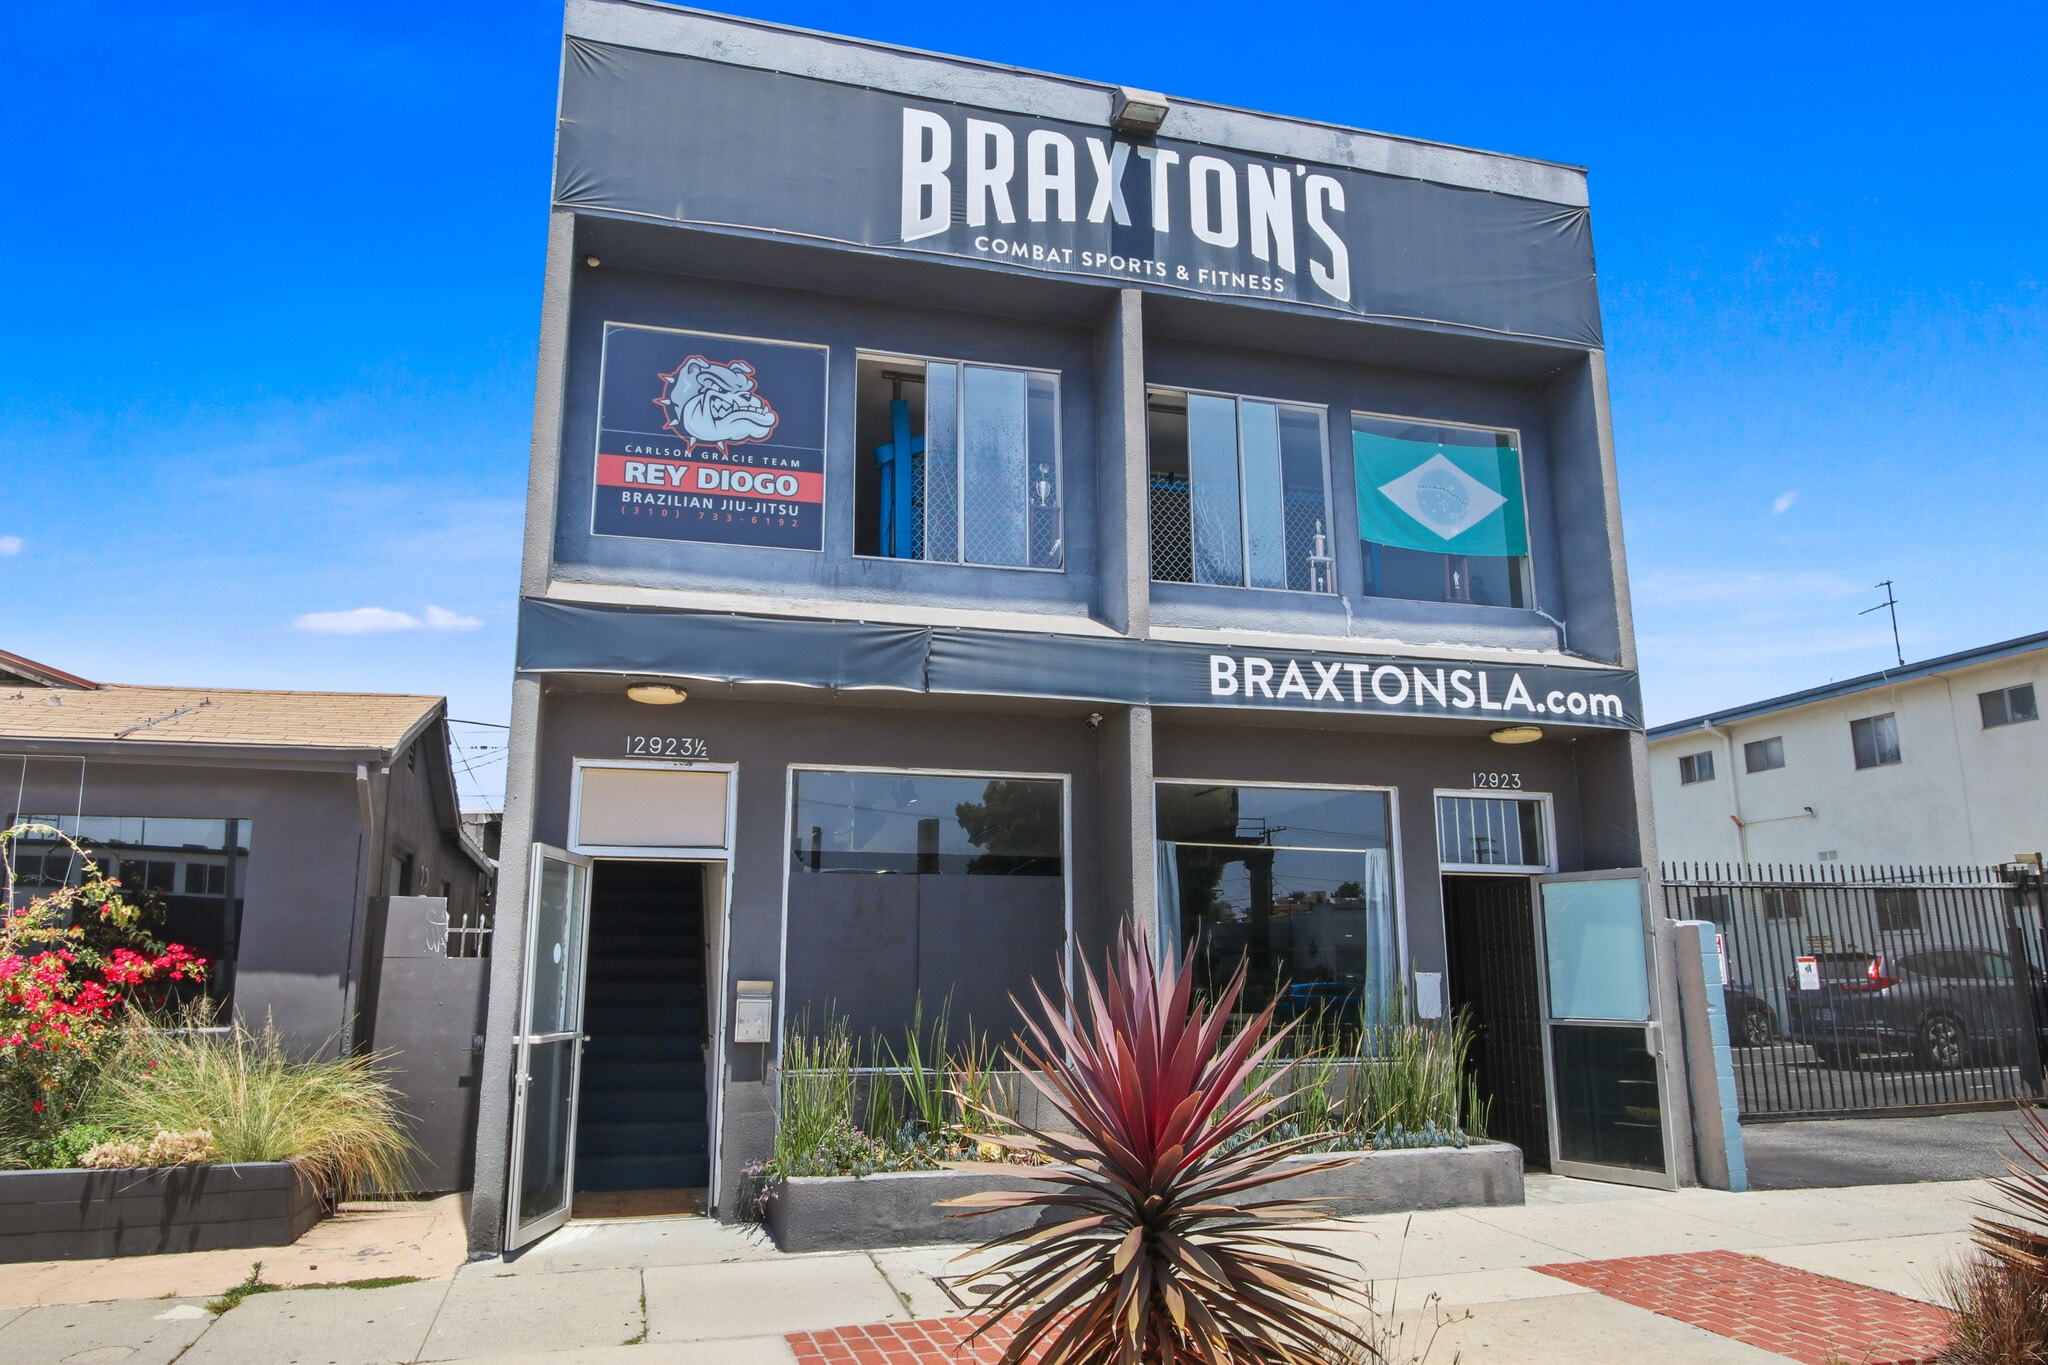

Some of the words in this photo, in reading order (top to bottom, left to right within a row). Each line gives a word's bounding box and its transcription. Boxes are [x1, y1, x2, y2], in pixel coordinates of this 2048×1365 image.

[901, 107, 1351, 303] BRAXTON'S
[974, 235, 1073, 265] COMBAT
[1081, 251, 1168, 277] SPORTS
[1176, 264, 1190, 281] &
[1198, 268, 1286, 293] FITNESS
[625, 444, 692, 458] CARLSON
[701, 451, 754, 464] GRACIE
[762, 456, 801, 468] TEAM
[624, 461, 689, 487] REY
[697, 467, 799, 496] DIOGO
[621, 506, 680, 518] (310)
[699, 512, 798, 527] 733-6192
[622, 491, 713, 509] BRAZILIAN
[720, 499, 799, 516] JIU-JITSU
[1210, 655, 1623, 718] BRAXTONSLA.com
[1472, 772, 1522, 789] 12923
